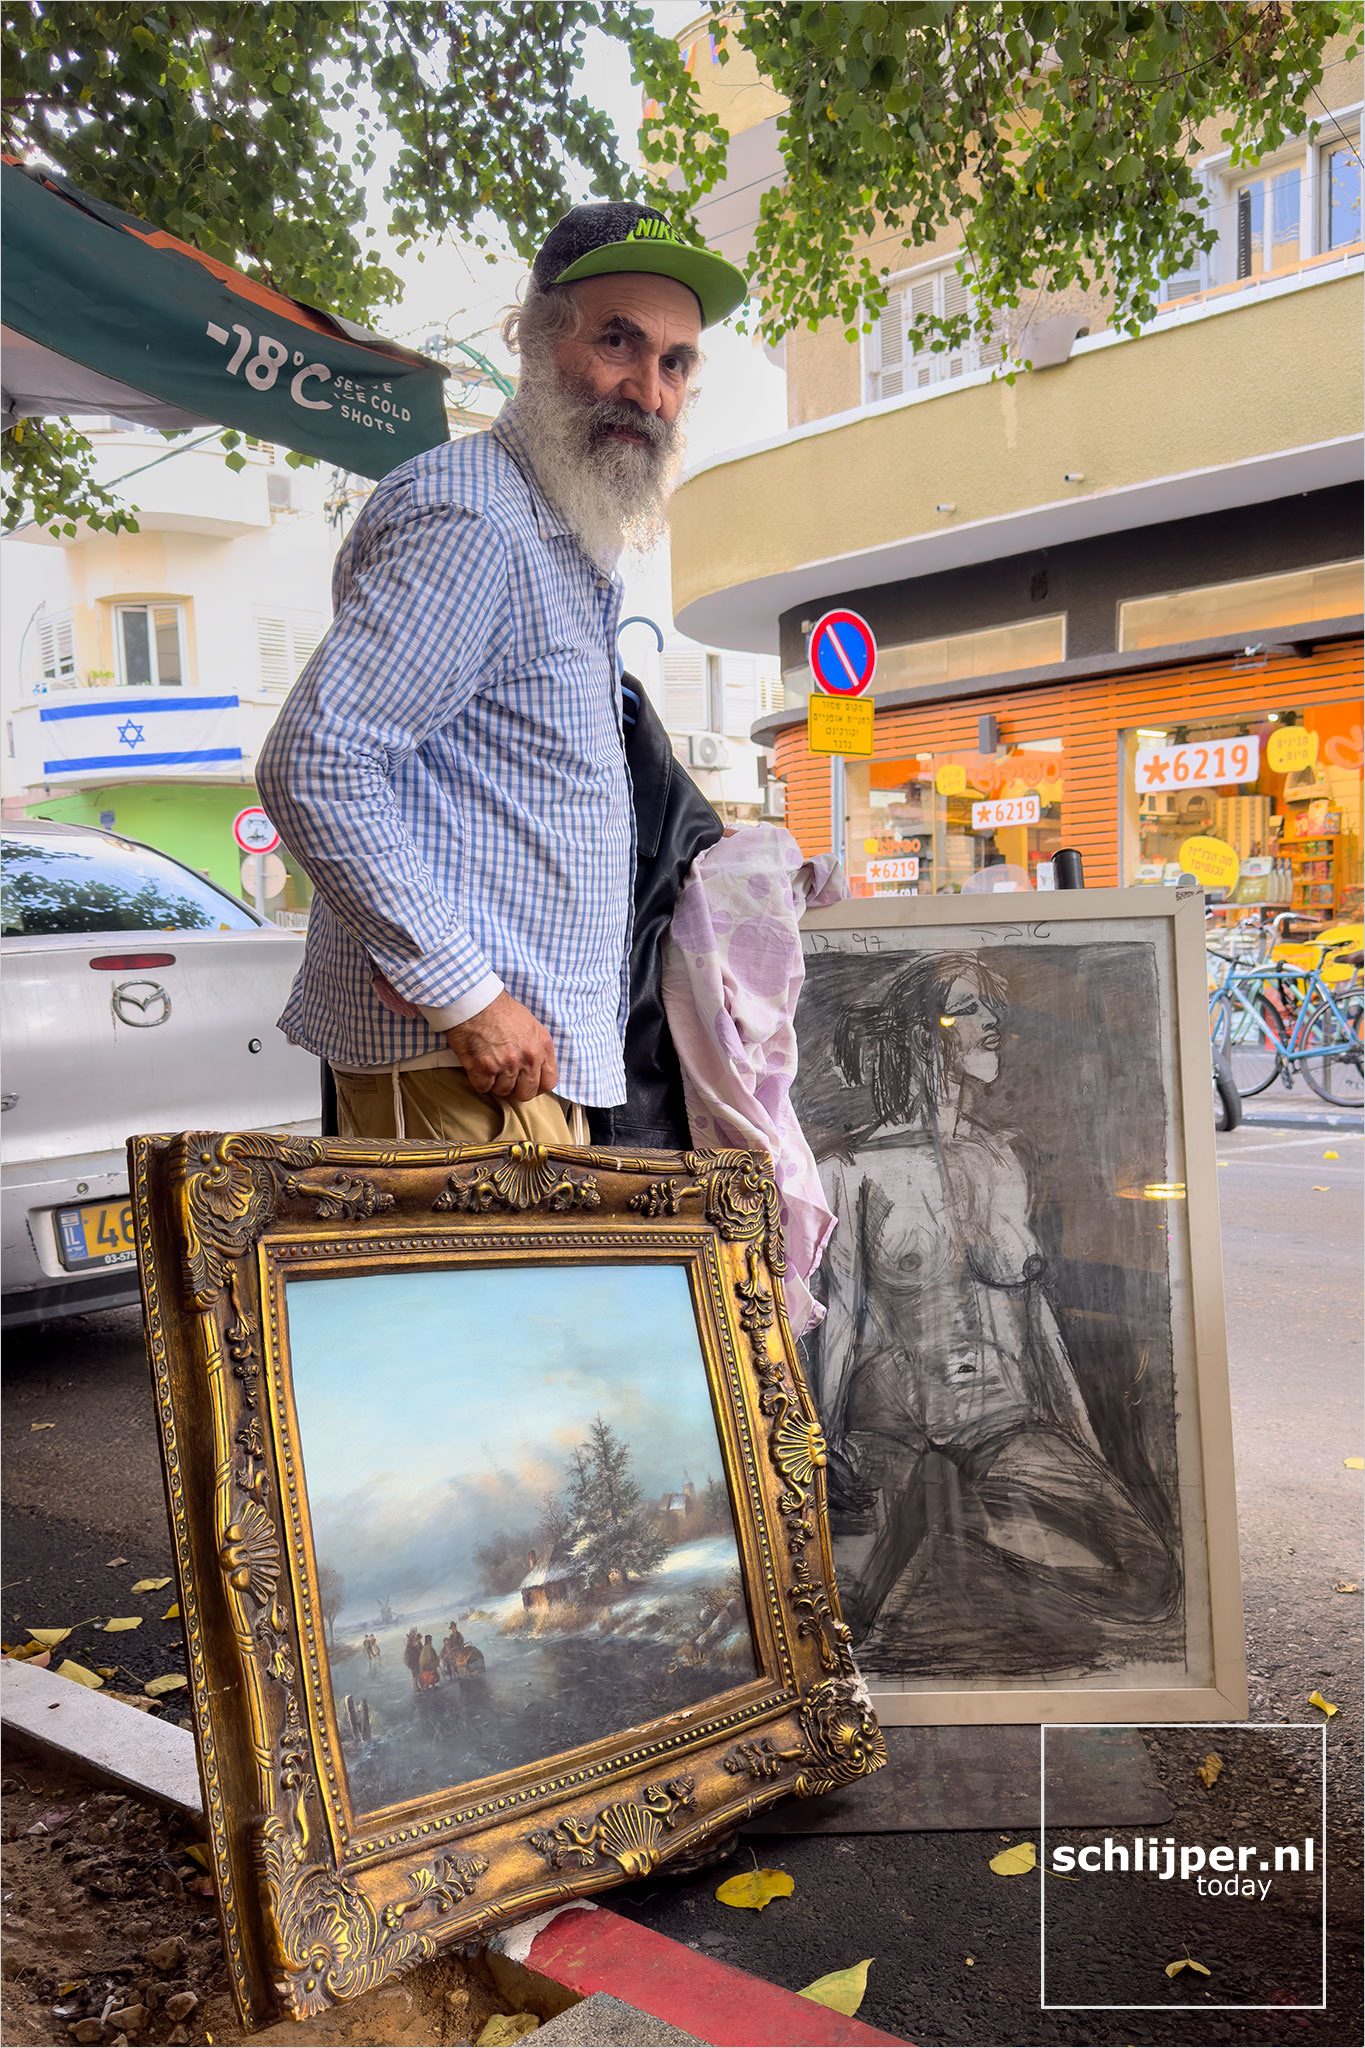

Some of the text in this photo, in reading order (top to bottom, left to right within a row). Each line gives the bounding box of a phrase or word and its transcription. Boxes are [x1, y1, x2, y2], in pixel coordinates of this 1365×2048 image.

[341, 404, 396, 435] SHOTS
[371, 395, 411, 422] COLD
[64, 1227, 80, 1247] IL
